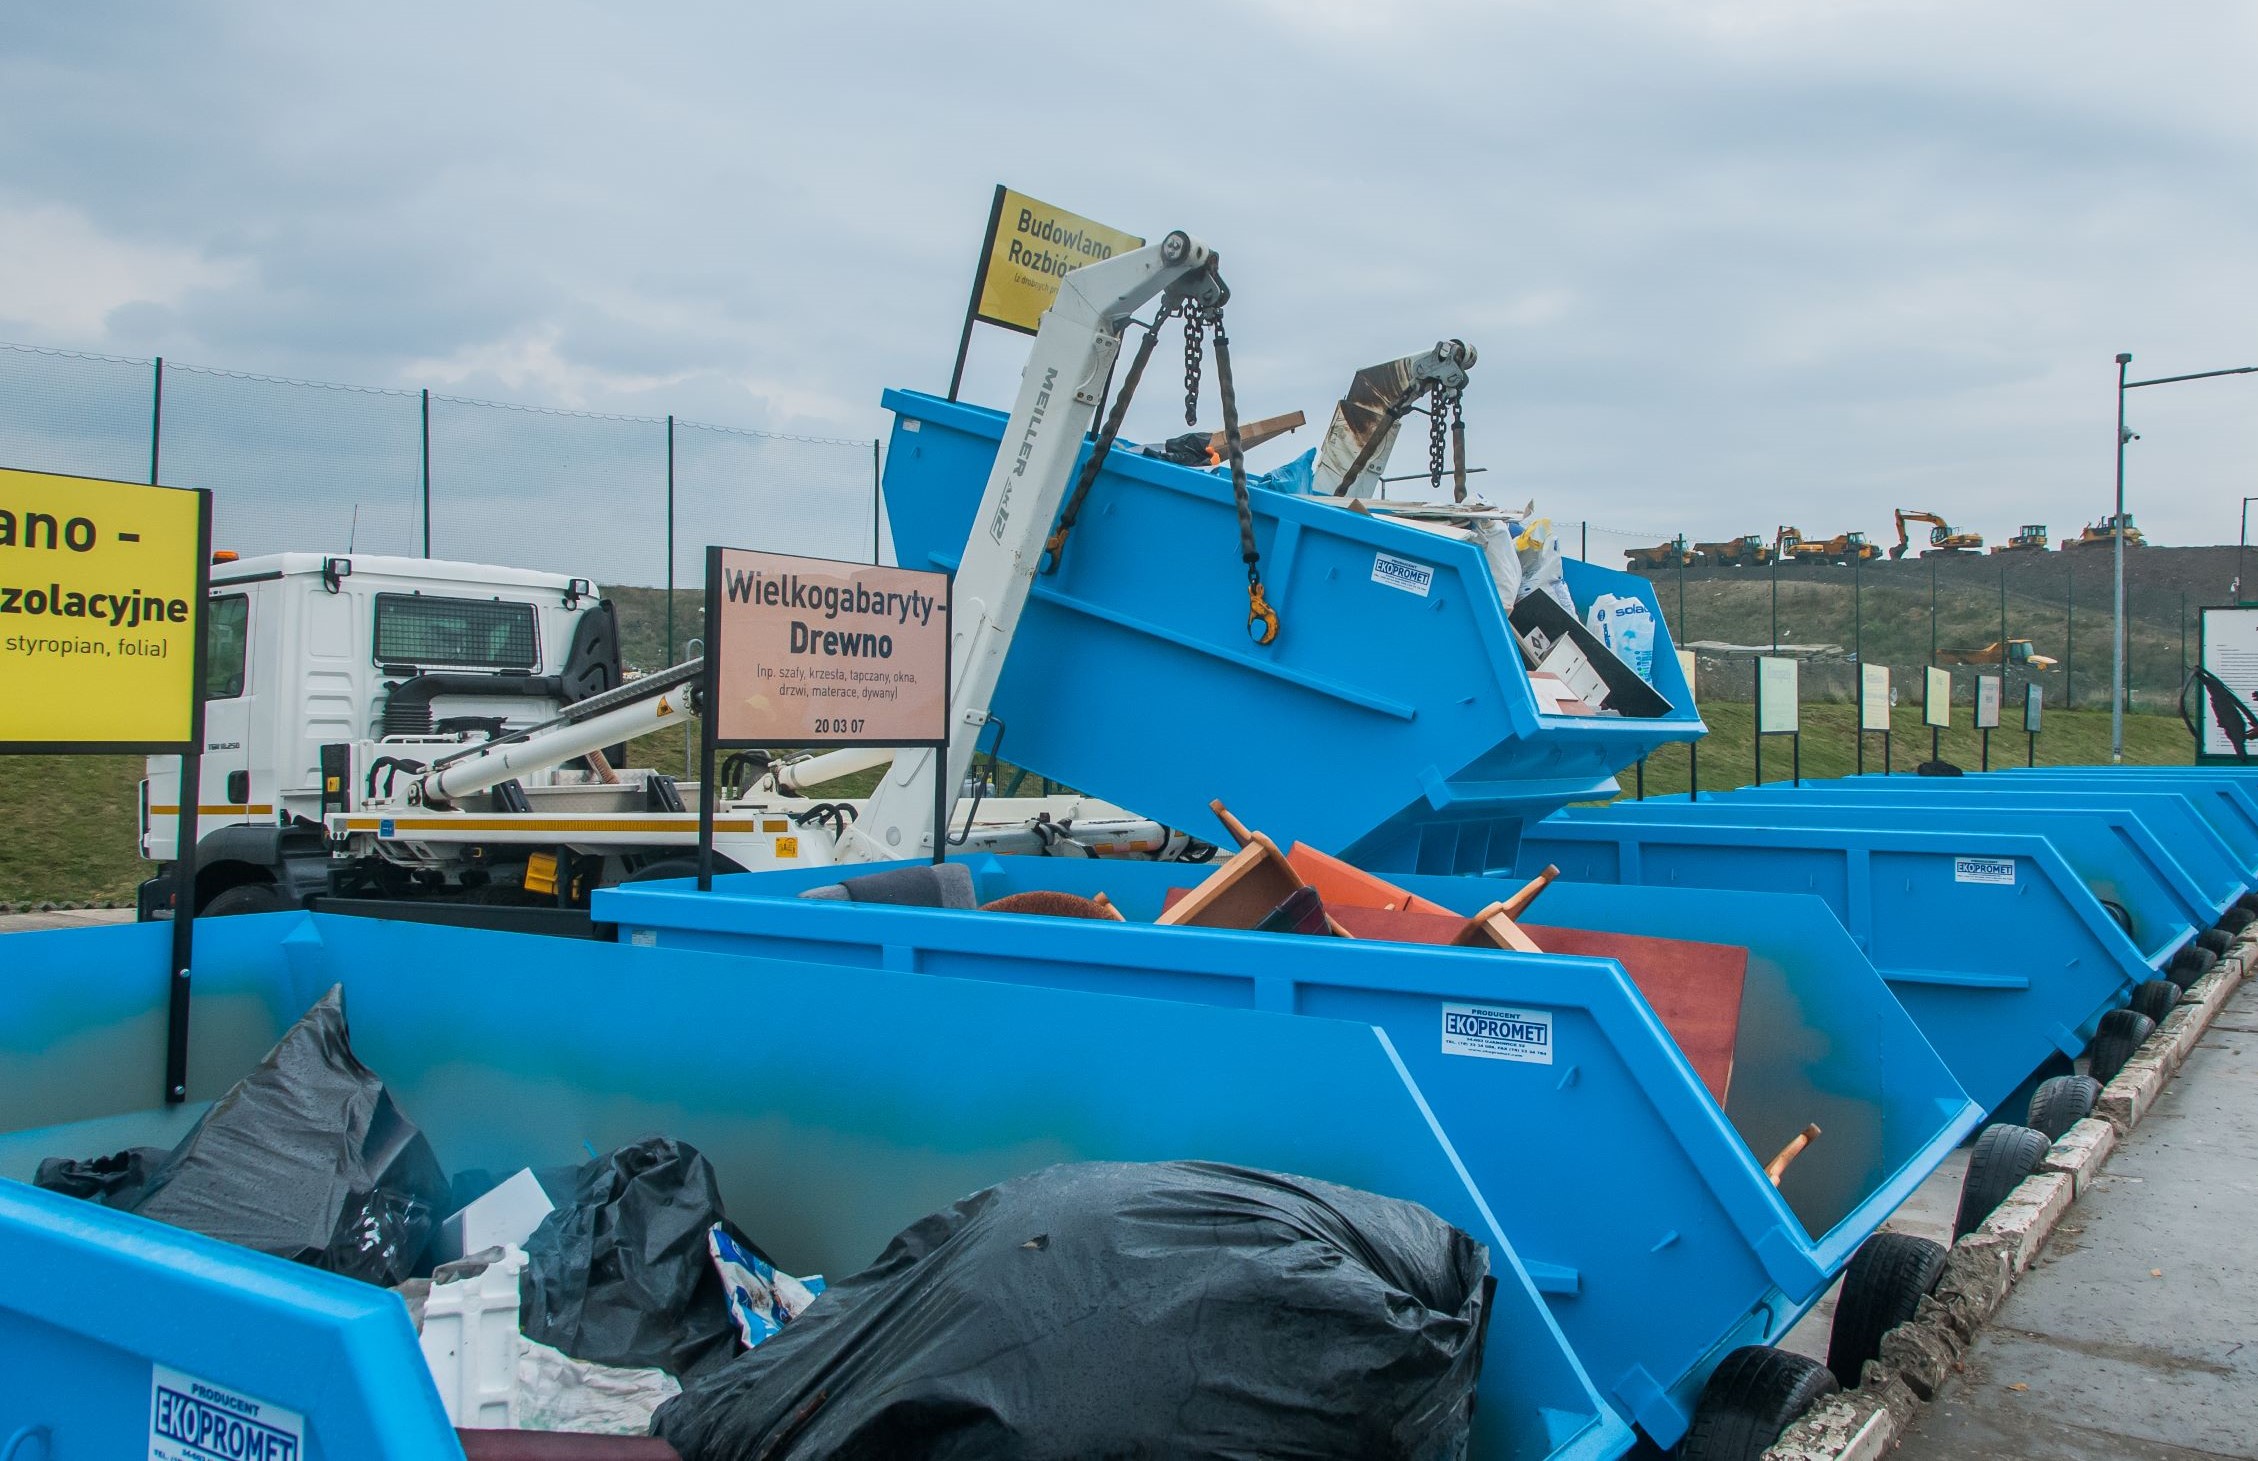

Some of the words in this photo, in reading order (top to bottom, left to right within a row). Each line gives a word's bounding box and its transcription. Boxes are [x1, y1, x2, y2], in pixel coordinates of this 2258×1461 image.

[1017, 208, 1112, 260] Budowlano
[1013, 367, 1058, 477] MEILLER
[1376, 560, 1429, 585] EKOPROMET
[0, 584, 188, 627] zolacyjne
[6, 635, 110, 657] styropian,
[119, 638, 167, 658] folia)
[790, 620, 893, 659] Drewno
[779, 667, 806, 680] szafy,
[850, 669, 891, 685] tapczany,
[893, 670, 917, 684] okna,
[779, 683, 809, 698] drzwi,
[812, 686, 860, 698] materace,
[815, 719, 829, 733] 20
[833, 719, 847, 733] 03
[851, 719, 865, 733] 07
[1957, 862, 2012, 875] EKOPROMET
[1471, 1008, 1521, 1020] PRODUCENT
[1447, 1014, 1544, 1042] EKOPROMET
[191, 1383, 260, 1417] PRODUCENT
[158, 1391, 293, 1461] EKOPROMET
